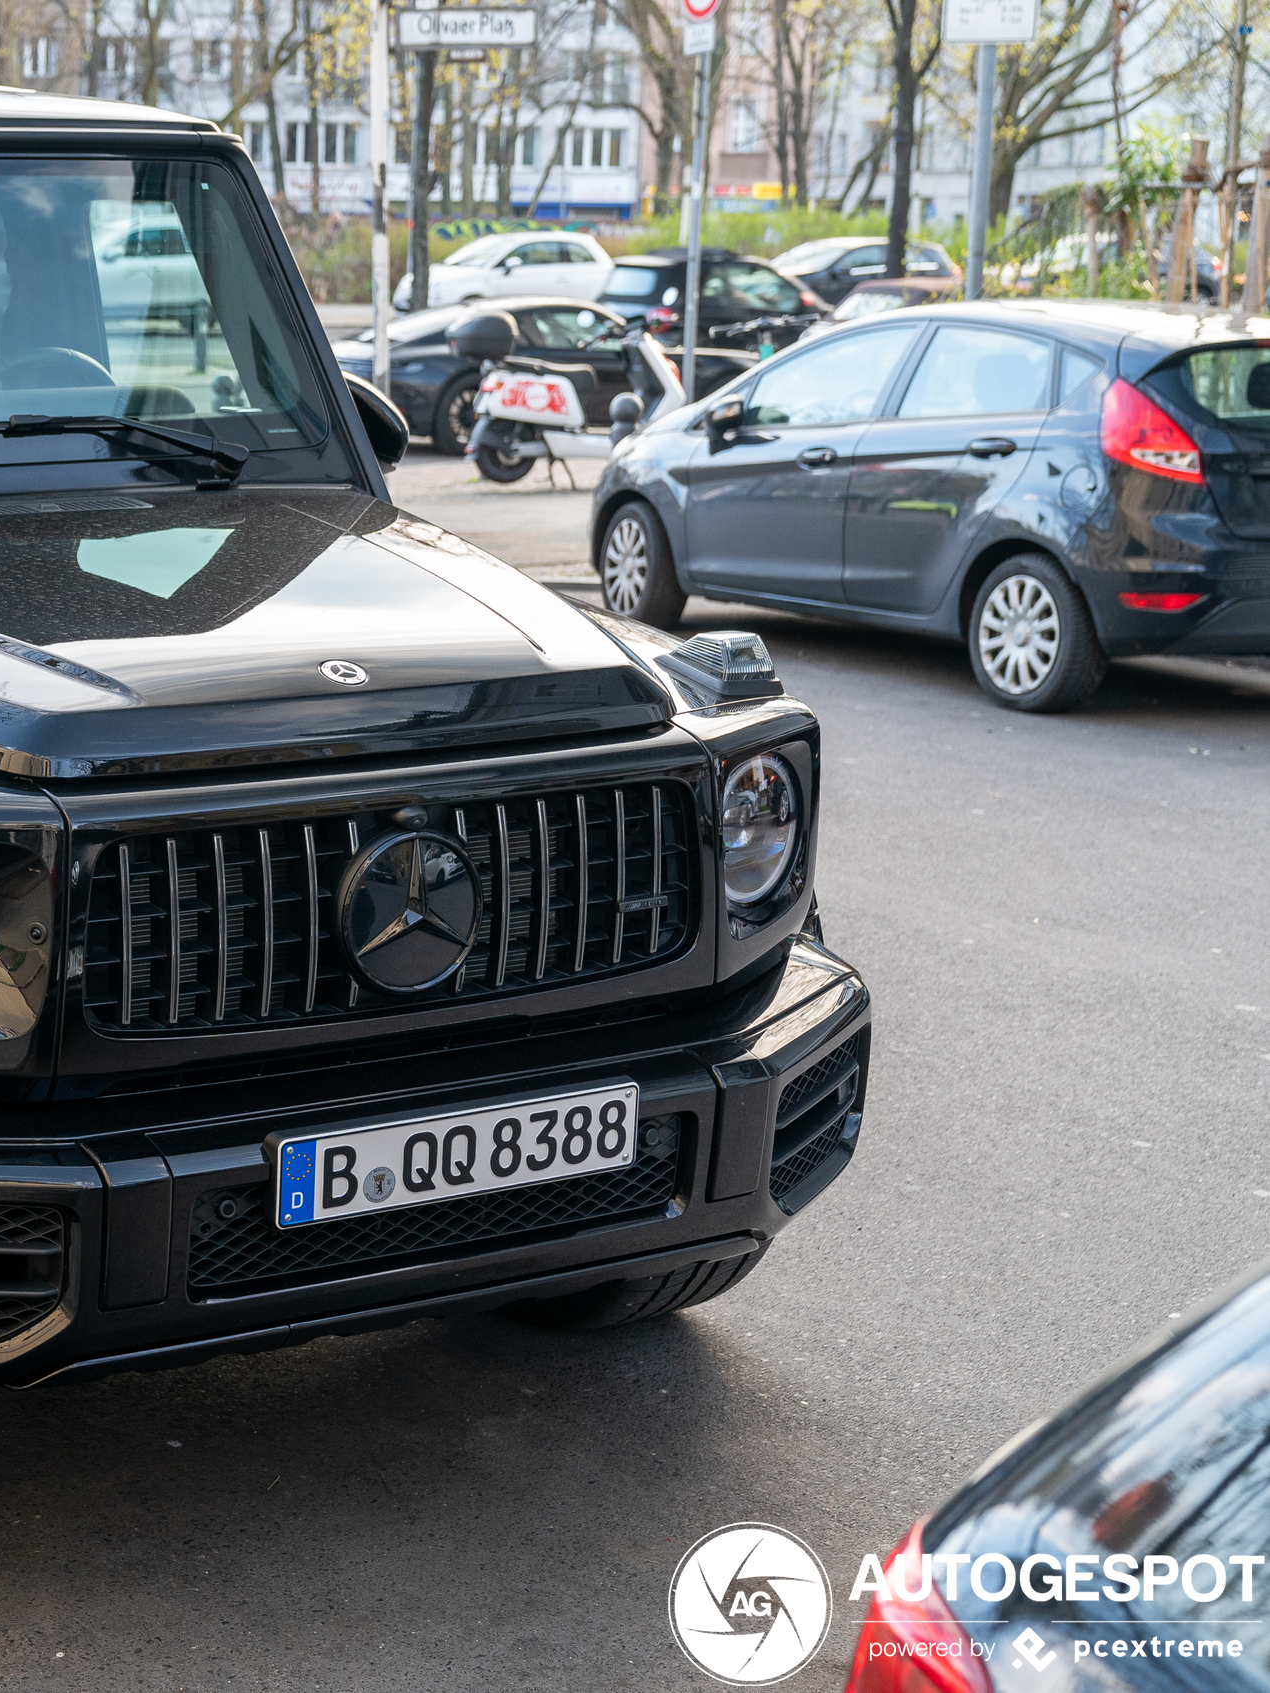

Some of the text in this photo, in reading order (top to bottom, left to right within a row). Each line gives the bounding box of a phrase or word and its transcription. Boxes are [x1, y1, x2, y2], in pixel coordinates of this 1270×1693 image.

[322, 1099, 627, 1209] B QQ 8388
[291, 1191, 304, 1210] D
